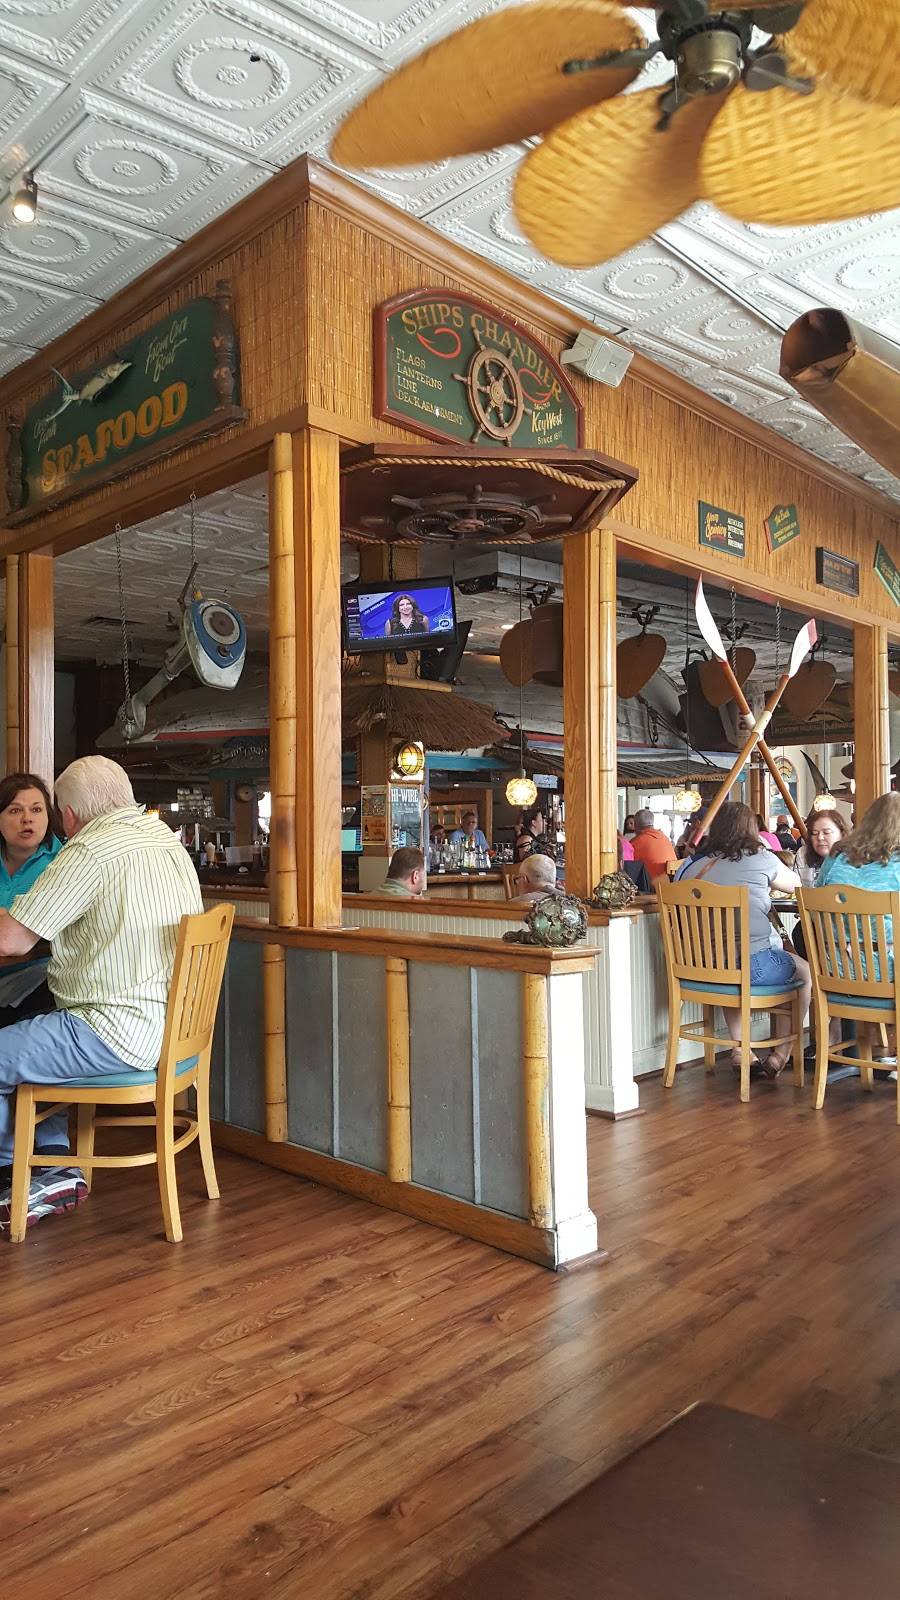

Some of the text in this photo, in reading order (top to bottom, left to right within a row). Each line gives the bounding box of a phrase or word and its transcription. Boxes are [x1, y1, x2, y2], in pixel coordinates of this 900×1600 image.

[395, 347, 426, 370] FLAGS
[402, 303, 562, 403] SHIPS CHANDLER
[397, 365, 443, 391] LANTERNS
[398, 376, 418, 394] LINE
[40, 381, 189, 493] SEAFOOD
[390, 788, 419, 803] HI-WIRE
